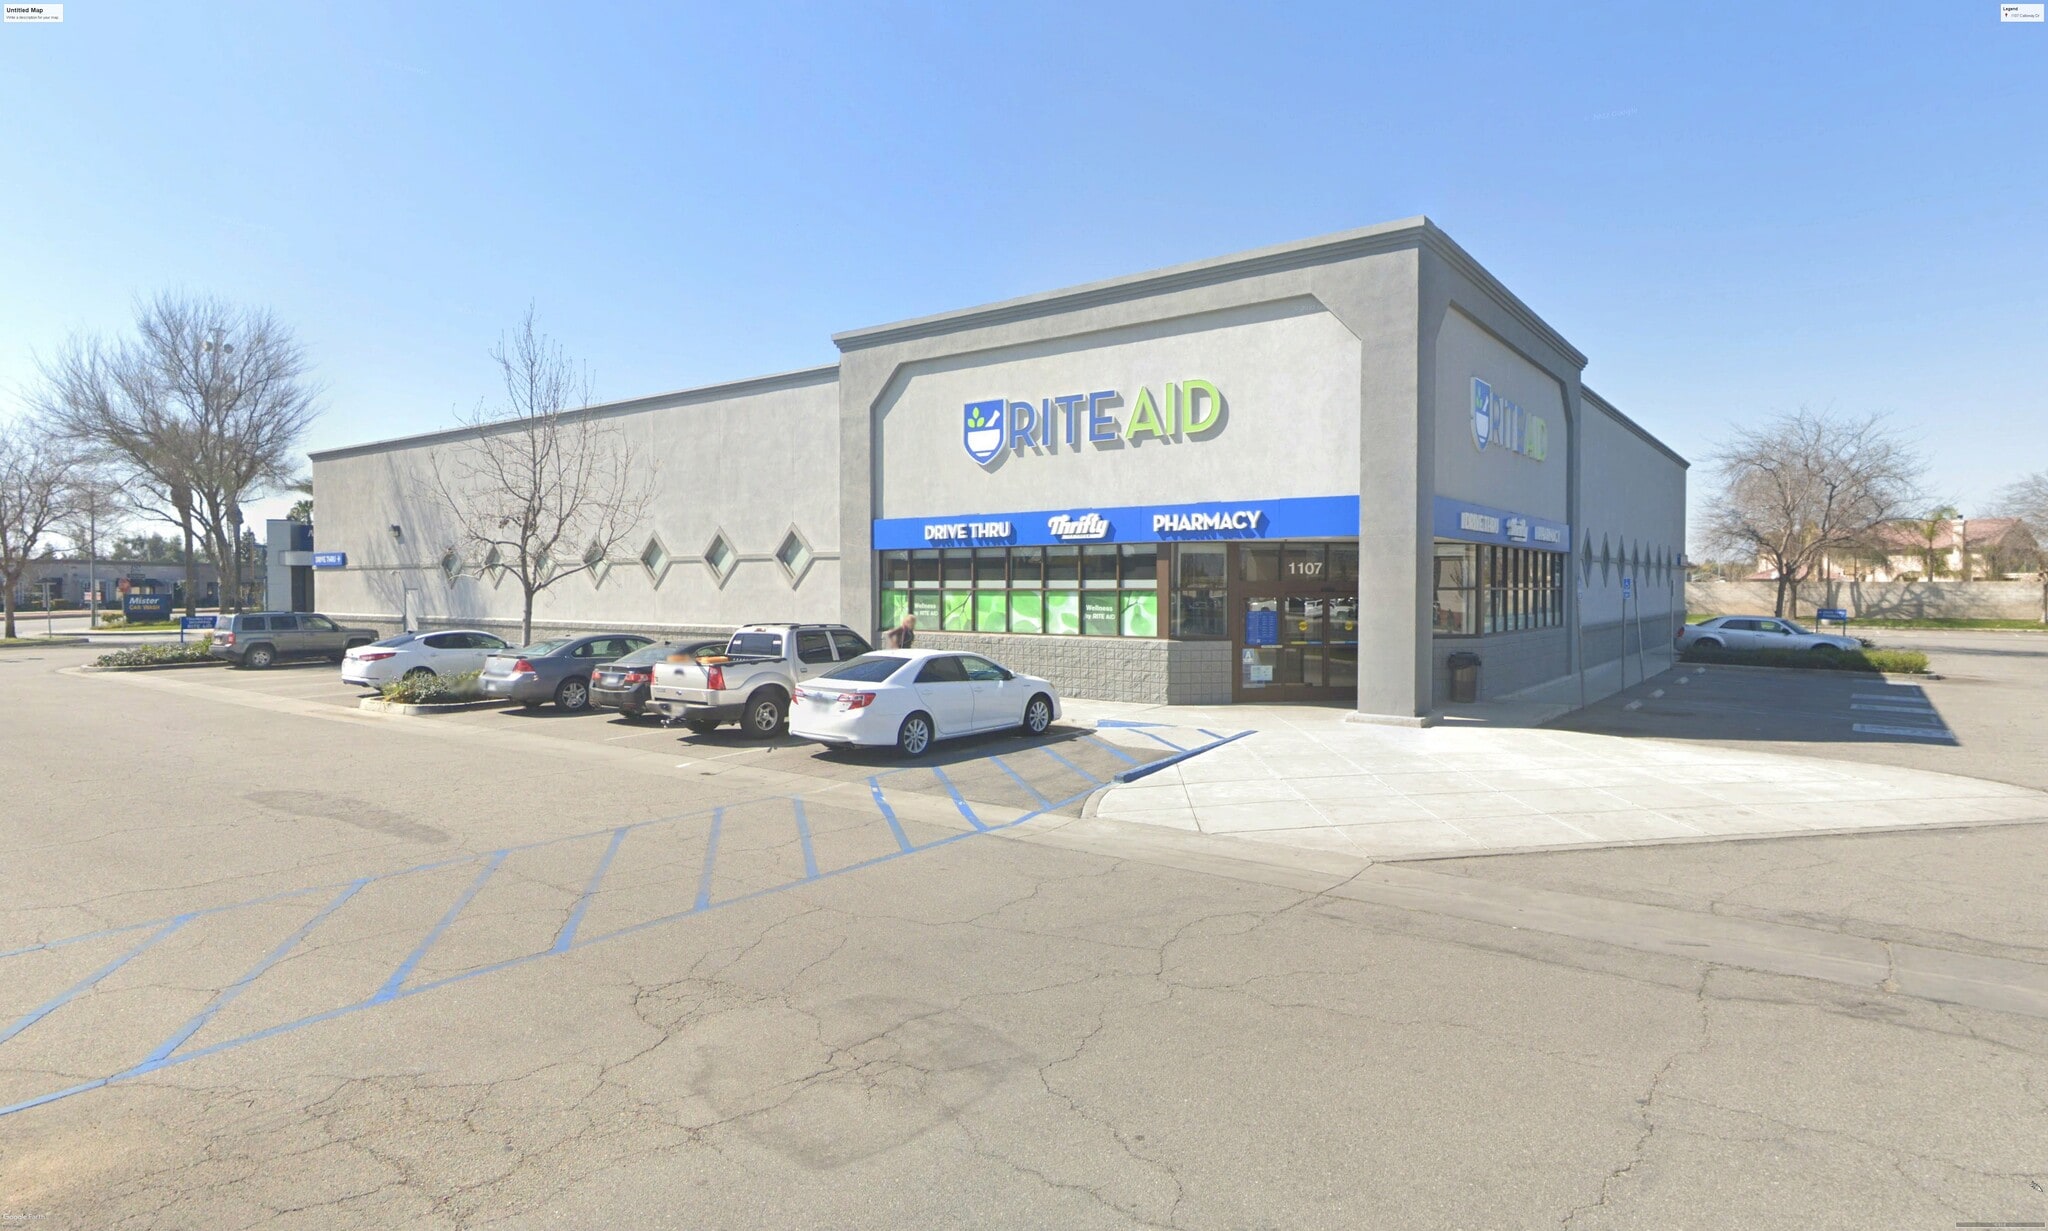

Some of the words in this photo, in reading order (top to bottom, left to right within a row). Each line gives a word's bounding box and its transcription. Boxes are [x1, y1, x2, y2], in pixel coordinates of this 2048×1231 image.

[1009, 390, 1117, 449] RITE
[1125, 378, 1222, 439] AID
[924, 523, 968, 541] DRIVE
[970, 521, 1012, 540] THRU
[1048, 512, 1110, 540] Thrifty
[1153, 510, 1262, 533] PHARMACY
[1288, 562, 1323, 575] 1107
[1085, 604, 1113, 612] Wellness
